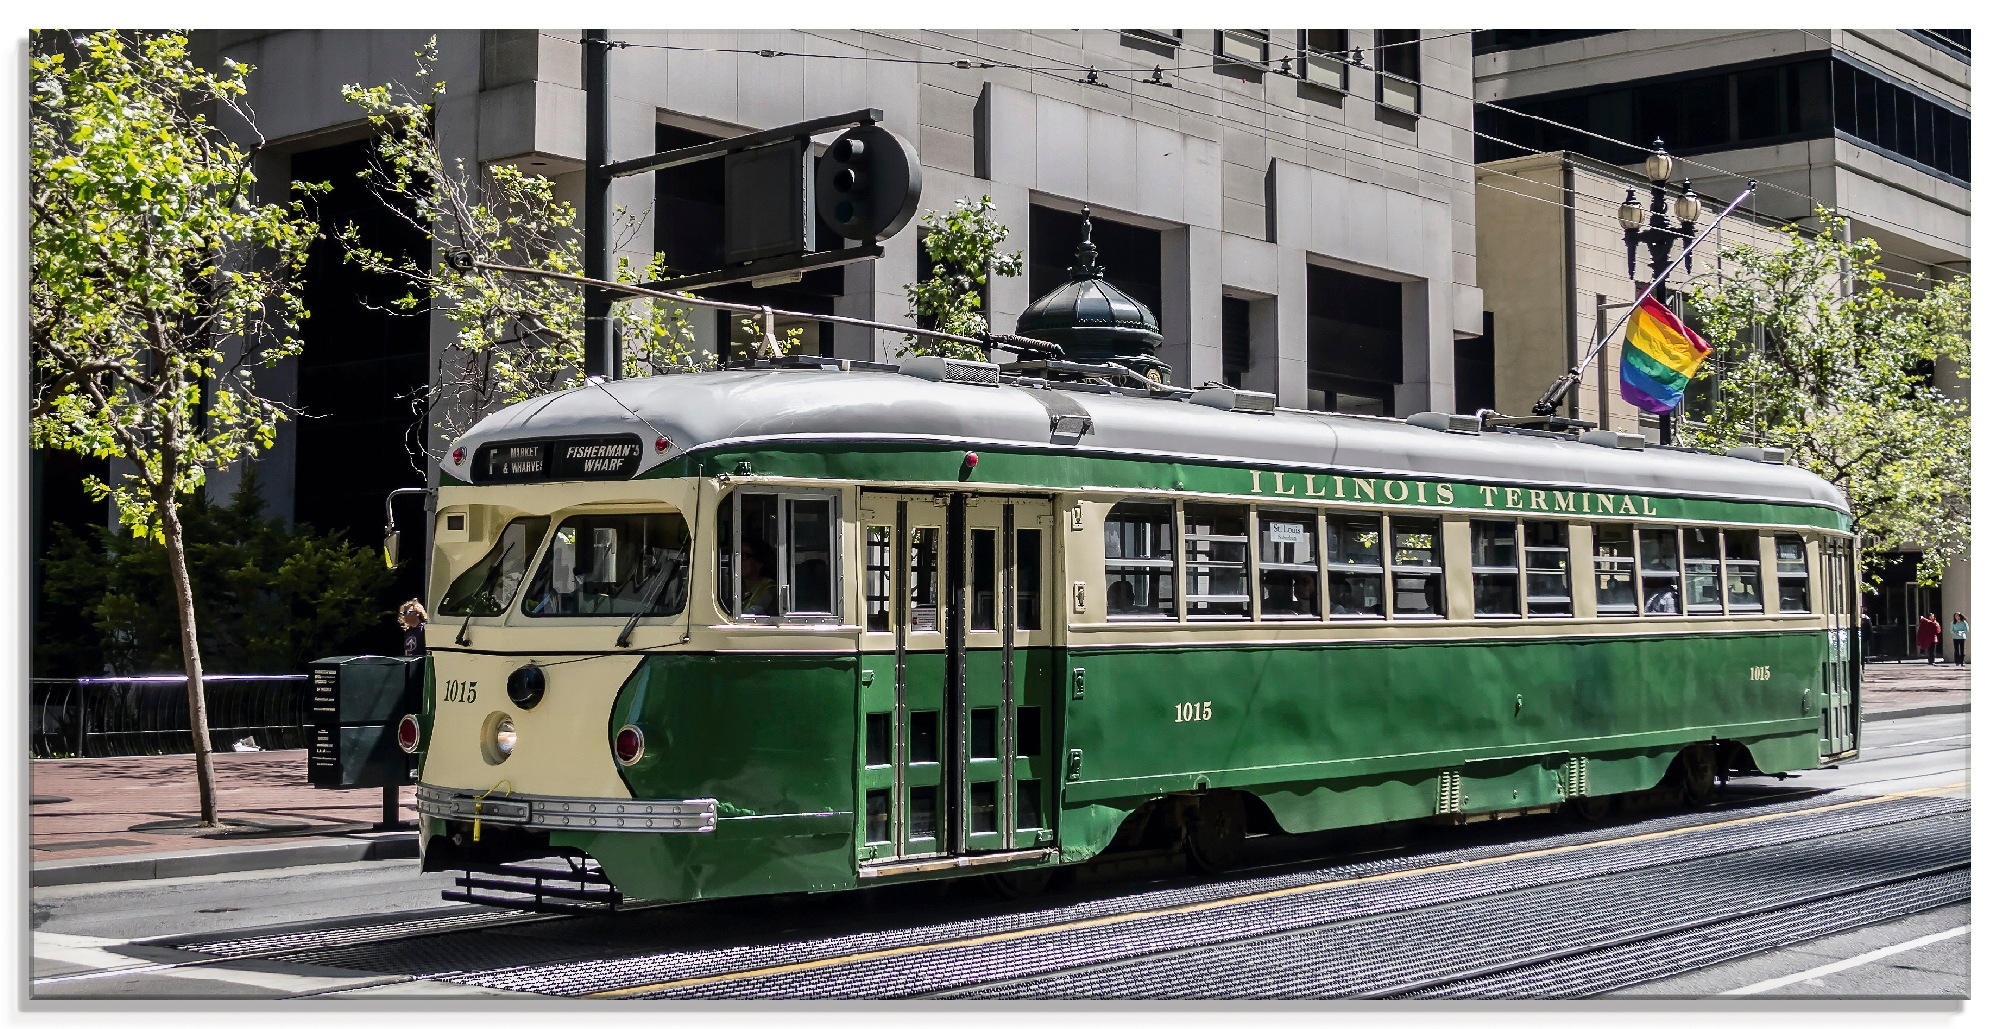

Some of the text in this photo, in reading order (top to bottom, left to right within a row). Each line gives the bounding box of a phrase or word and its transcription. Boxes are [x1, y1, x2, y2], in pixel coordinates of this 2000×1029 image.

[510, 446, 539, 459] MARKET
[566, 444, 640, 459] FISHERMAN'S
[488, 448, 498, 475] F
[502, 462, 509, 474] &
[584, 458, 625, 472] WHARF
[1249, 469, 1657, 516] ILLINOIS TERMINAL
[1284, 524, 1301, 534] Louis
[1749, 665, 1771, 681] 1015
[443, 679, 478, 704] 1015
[1174, 700, 1213, 723] 1015
